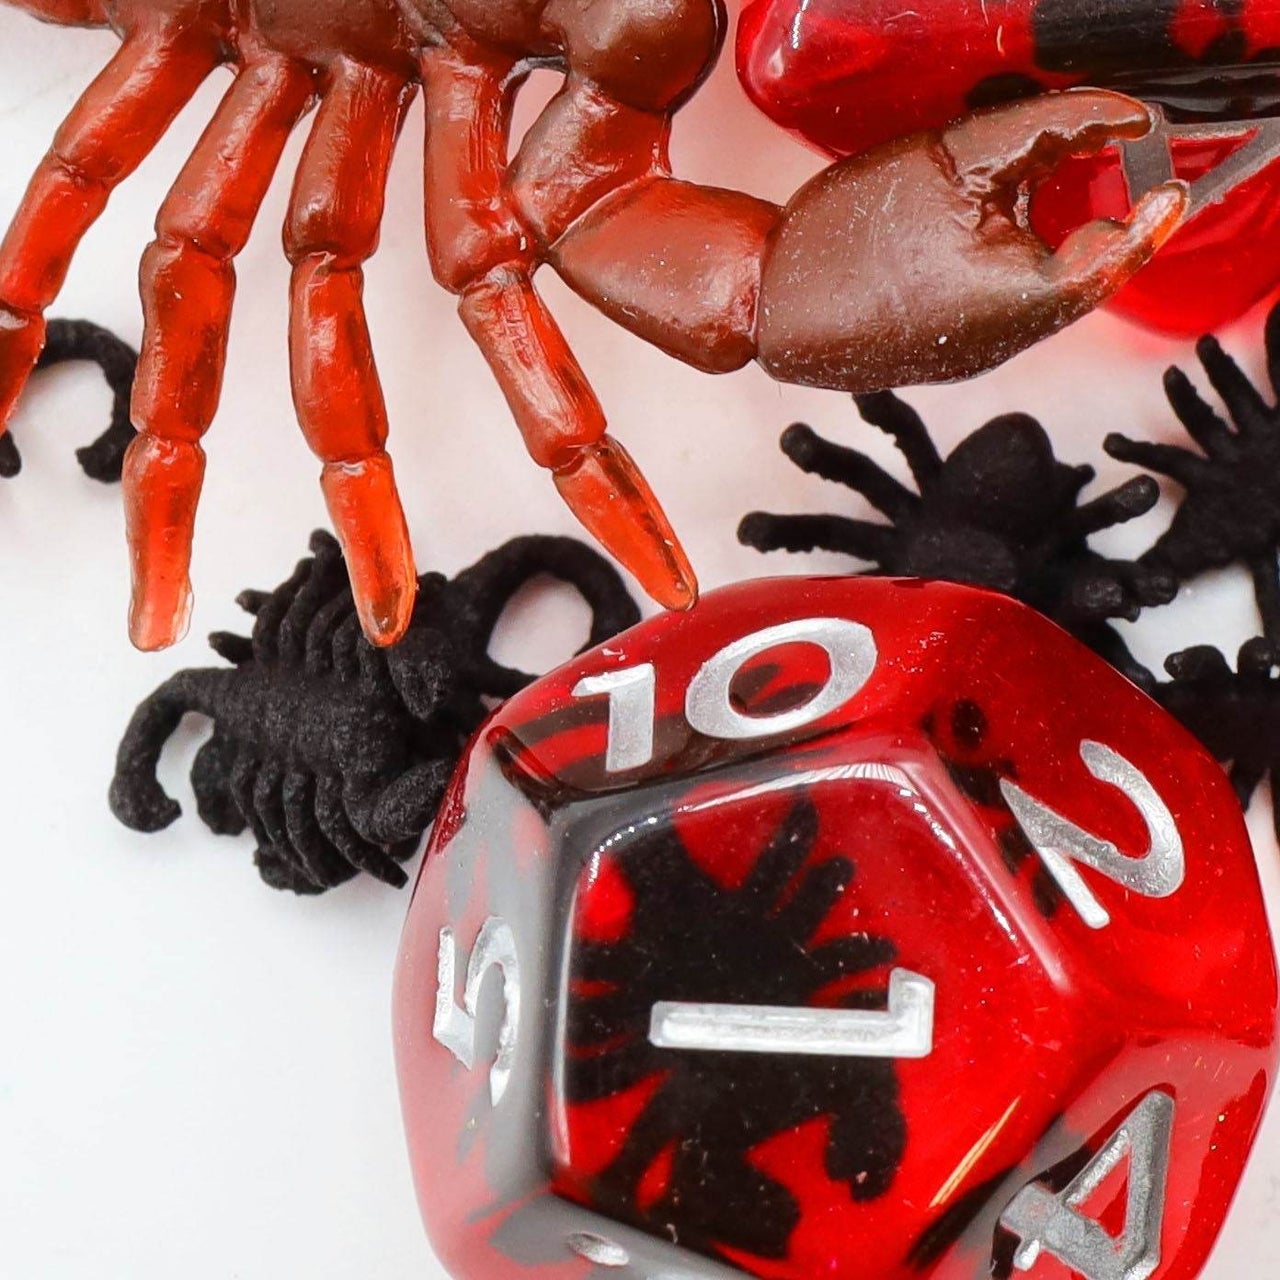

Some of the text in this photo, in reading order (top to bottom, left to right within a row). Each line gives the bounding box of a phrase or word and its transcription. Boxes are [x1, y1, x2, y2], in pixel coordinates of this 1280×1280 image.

[572, 616, 878, 772] 10
[1000, 739, 1186, 929] 2
[433, 916, 520, 1106] 5
[649, 967, 934, 1059] 1
[1000, 1089, 1175, 1280] 4
